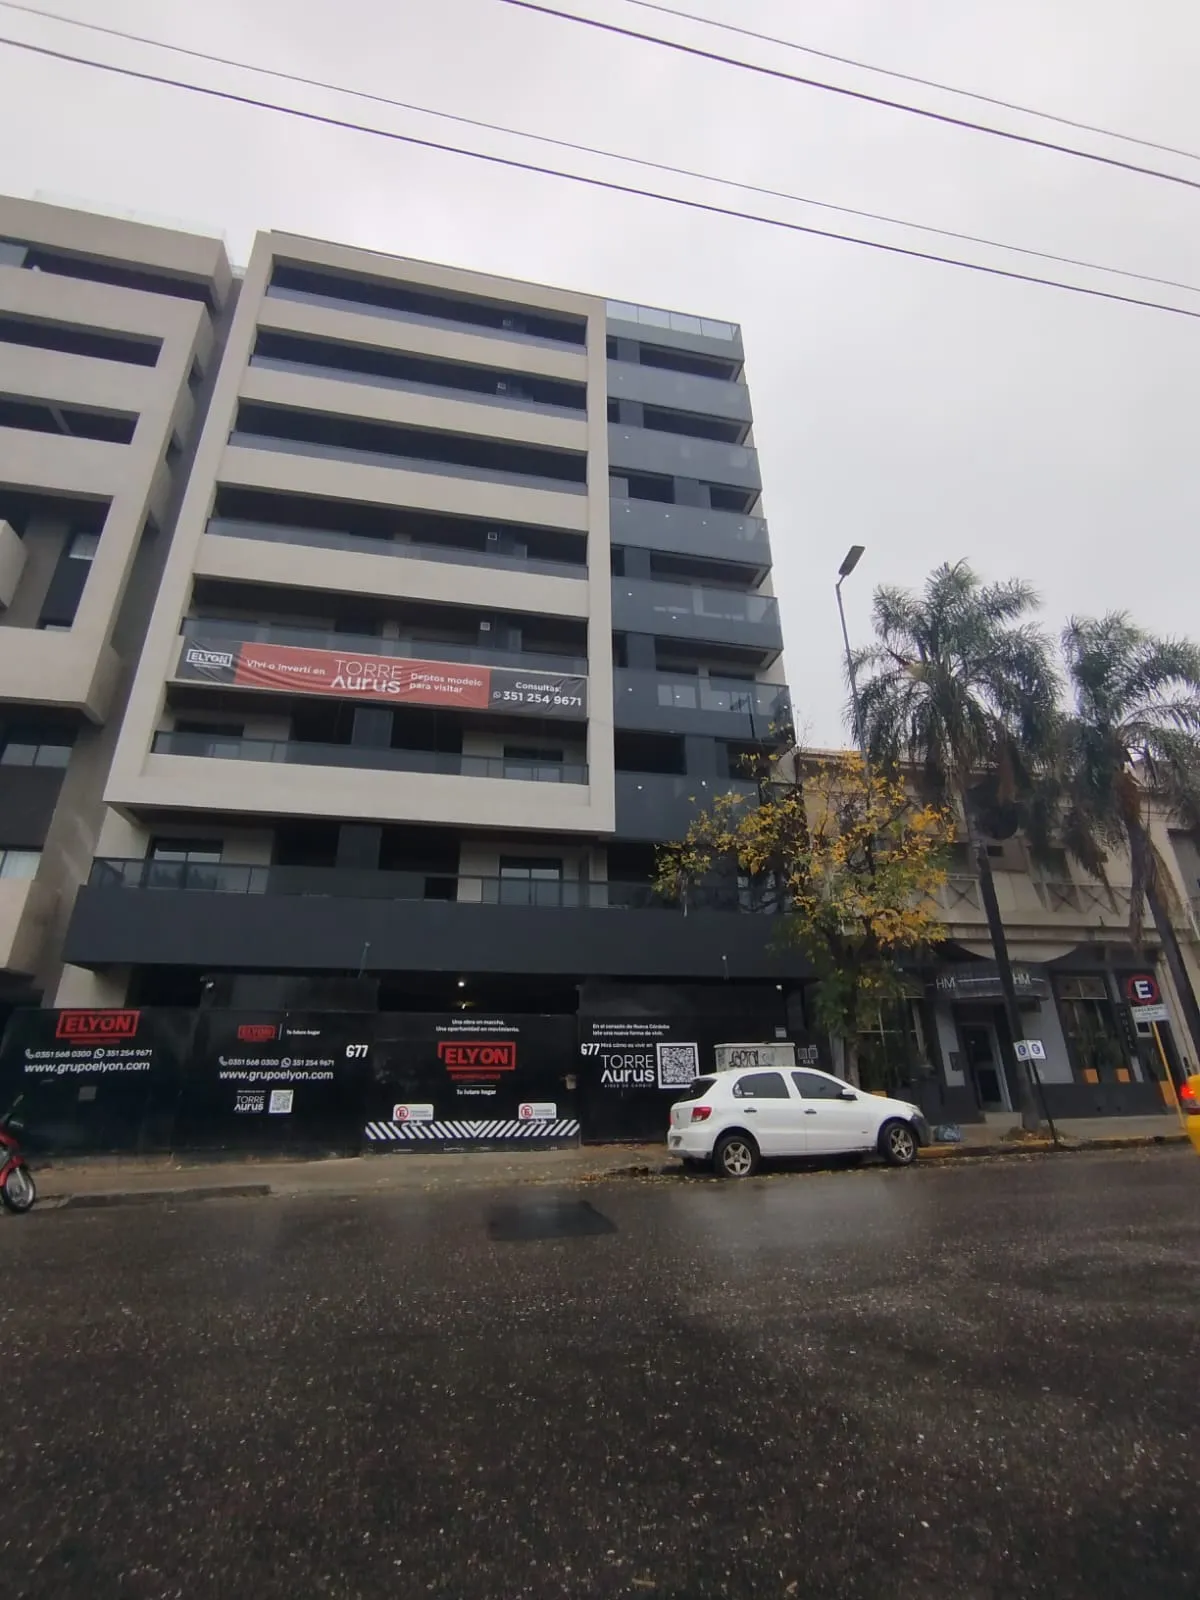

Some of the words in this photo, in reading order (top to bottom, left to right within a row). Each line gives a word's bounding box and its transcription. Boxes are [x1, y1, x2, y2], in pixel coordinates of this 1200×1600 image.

[191, 651, 229, 664] ELYON
[335, 659, 403, 680] TORRE
[410, 672, 445, 683] Deptos
[447, 675, 483, 686] modelo
[409, 681, 431, 690] para
[433, 684, 464, 693] visitar
[503, 690, 523, 701] 351
[527, 693, 550, 703] 254
[553, 697, 582, 706] 9671
[936, 977, 956, 990] HM
[1012, 973, 1031, 985] HM
[1134, 980, 1152, 999] E
[65, 1015, 132, 1033] ELYON
[135, 1049, 152, 1057] 9671
[345, 1044, 368, 1058] 677
[580, 1043, 600, 1055] 677
[445, 1048, 508, 1065] ELYON
[600, 1054, 654, 1069] TORRE
[24, 1061, 150, 1074] www.grupoelyon.com
[219, 1070, 334, 1082] www.grupoelyon.com
[236, 1095, 265, 1104] TORRE
